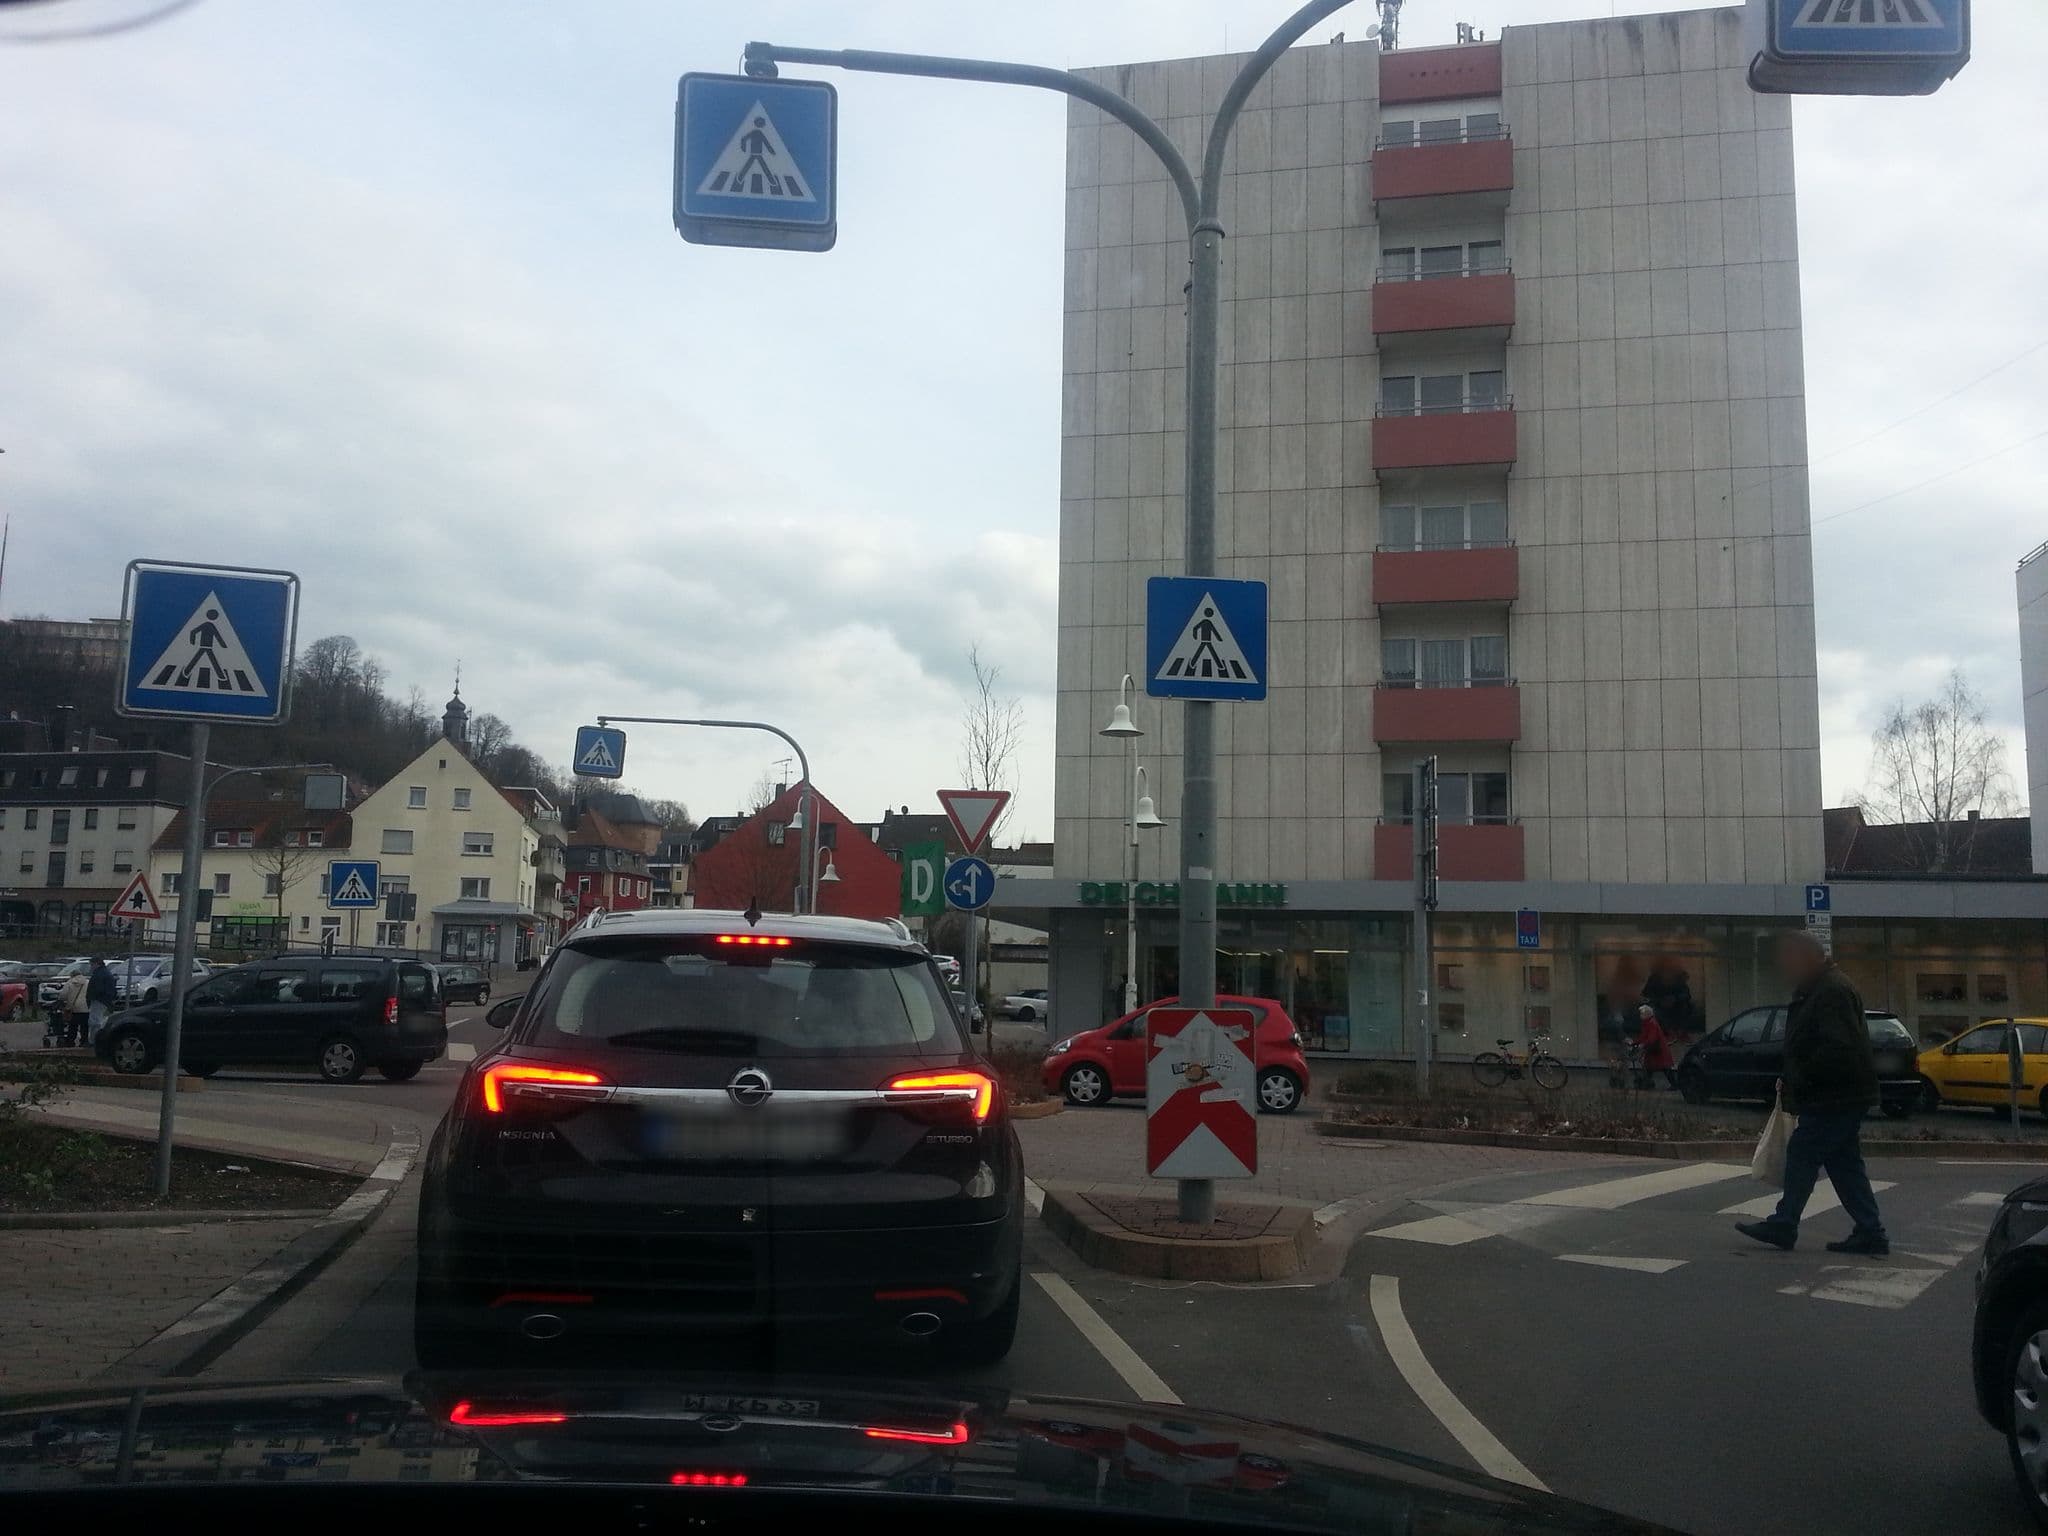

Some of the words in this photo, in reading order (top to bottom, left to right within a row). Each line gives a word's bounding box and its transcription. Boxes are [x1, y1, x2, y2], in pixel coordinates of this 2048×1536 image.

[911, 858, 934, 903] D
[1080, 882, 1289, 905] DECHANN
[1811, 888, 1825, 908] P
[1520, 935, 1538, 945] TAXI
[498, 1129, 556, 1141] INSIGNIA
[926, 1135, 974, 1144] BITURBO
